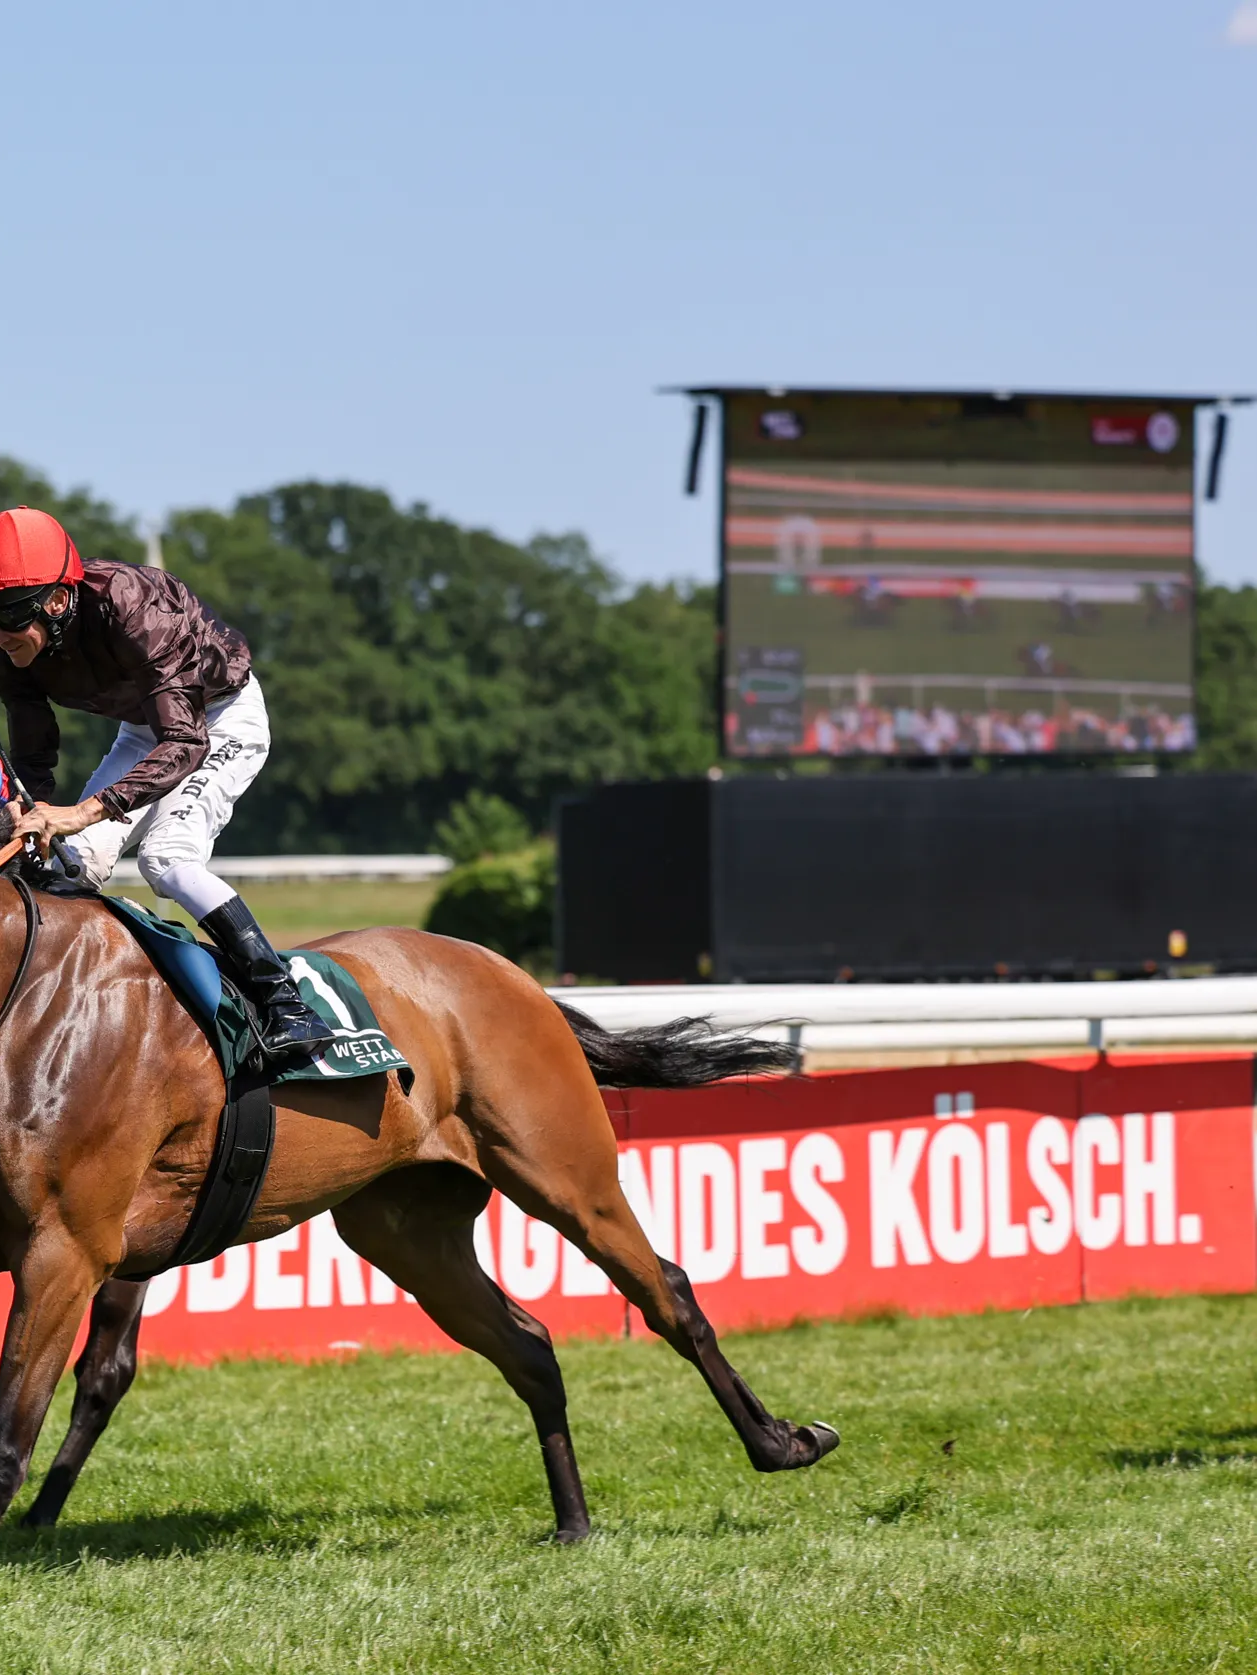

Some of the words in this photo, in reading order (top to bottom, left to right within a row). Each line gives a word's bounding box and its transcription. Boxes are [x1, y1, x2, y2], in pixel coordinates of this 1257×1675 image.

[181, 775, 210, 799] DE
[170, 804, 194, 820] A.
[288, 955, 358, 1031] 1
[332, 1038, 384, 1059] WETT
[355, 1048, 406, 1069] STAR
[867, 1091, 1203, 1269] KÖLSCH.
